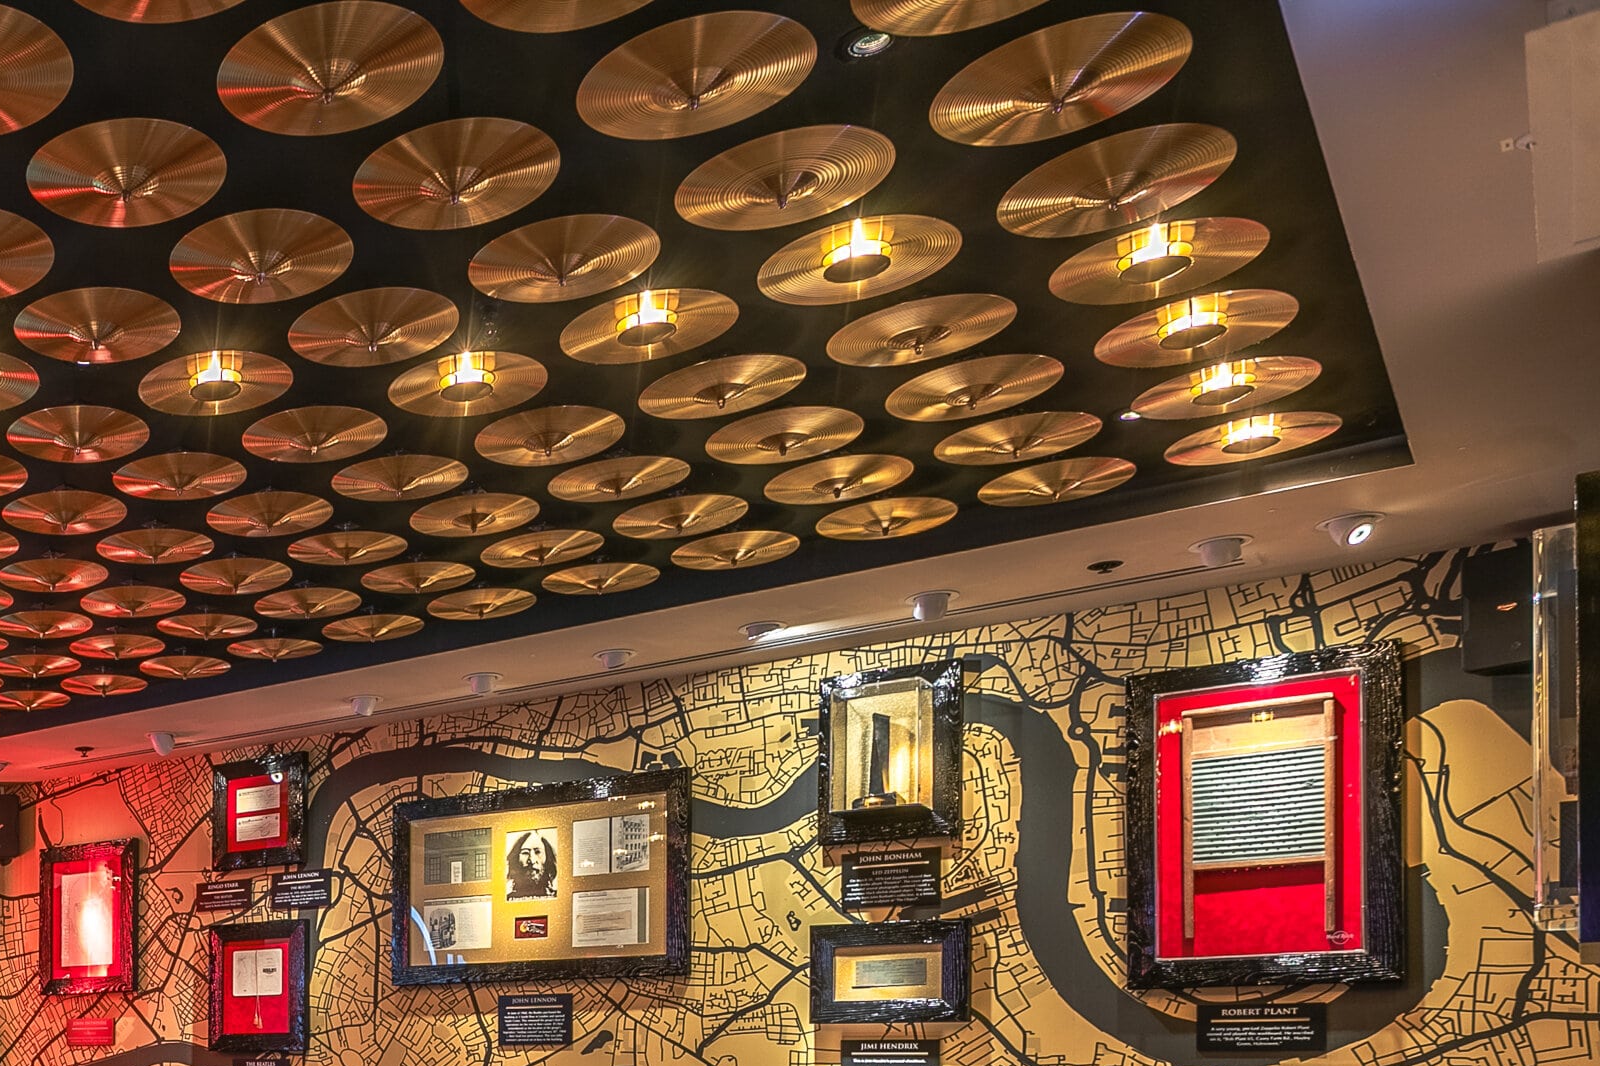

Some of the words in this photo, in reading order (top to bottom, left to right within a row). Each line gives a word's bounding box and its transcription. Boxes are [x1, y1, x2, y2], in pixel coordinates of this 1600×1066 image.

[860, 855, 882, 864] JOHN
[884, 852, 922, 861] BONHAM
[297, 871, 320, 879] LENNON
[530, 996, 557, 1004] LENNON
[1221, 1008, 1262, 1016] ROBERT
[1264, 1007, 1299, 1015] PLANT
[860, 1043, 878, 1051] JIMI
[880, 1042, 919, 1050] HENDRIX
